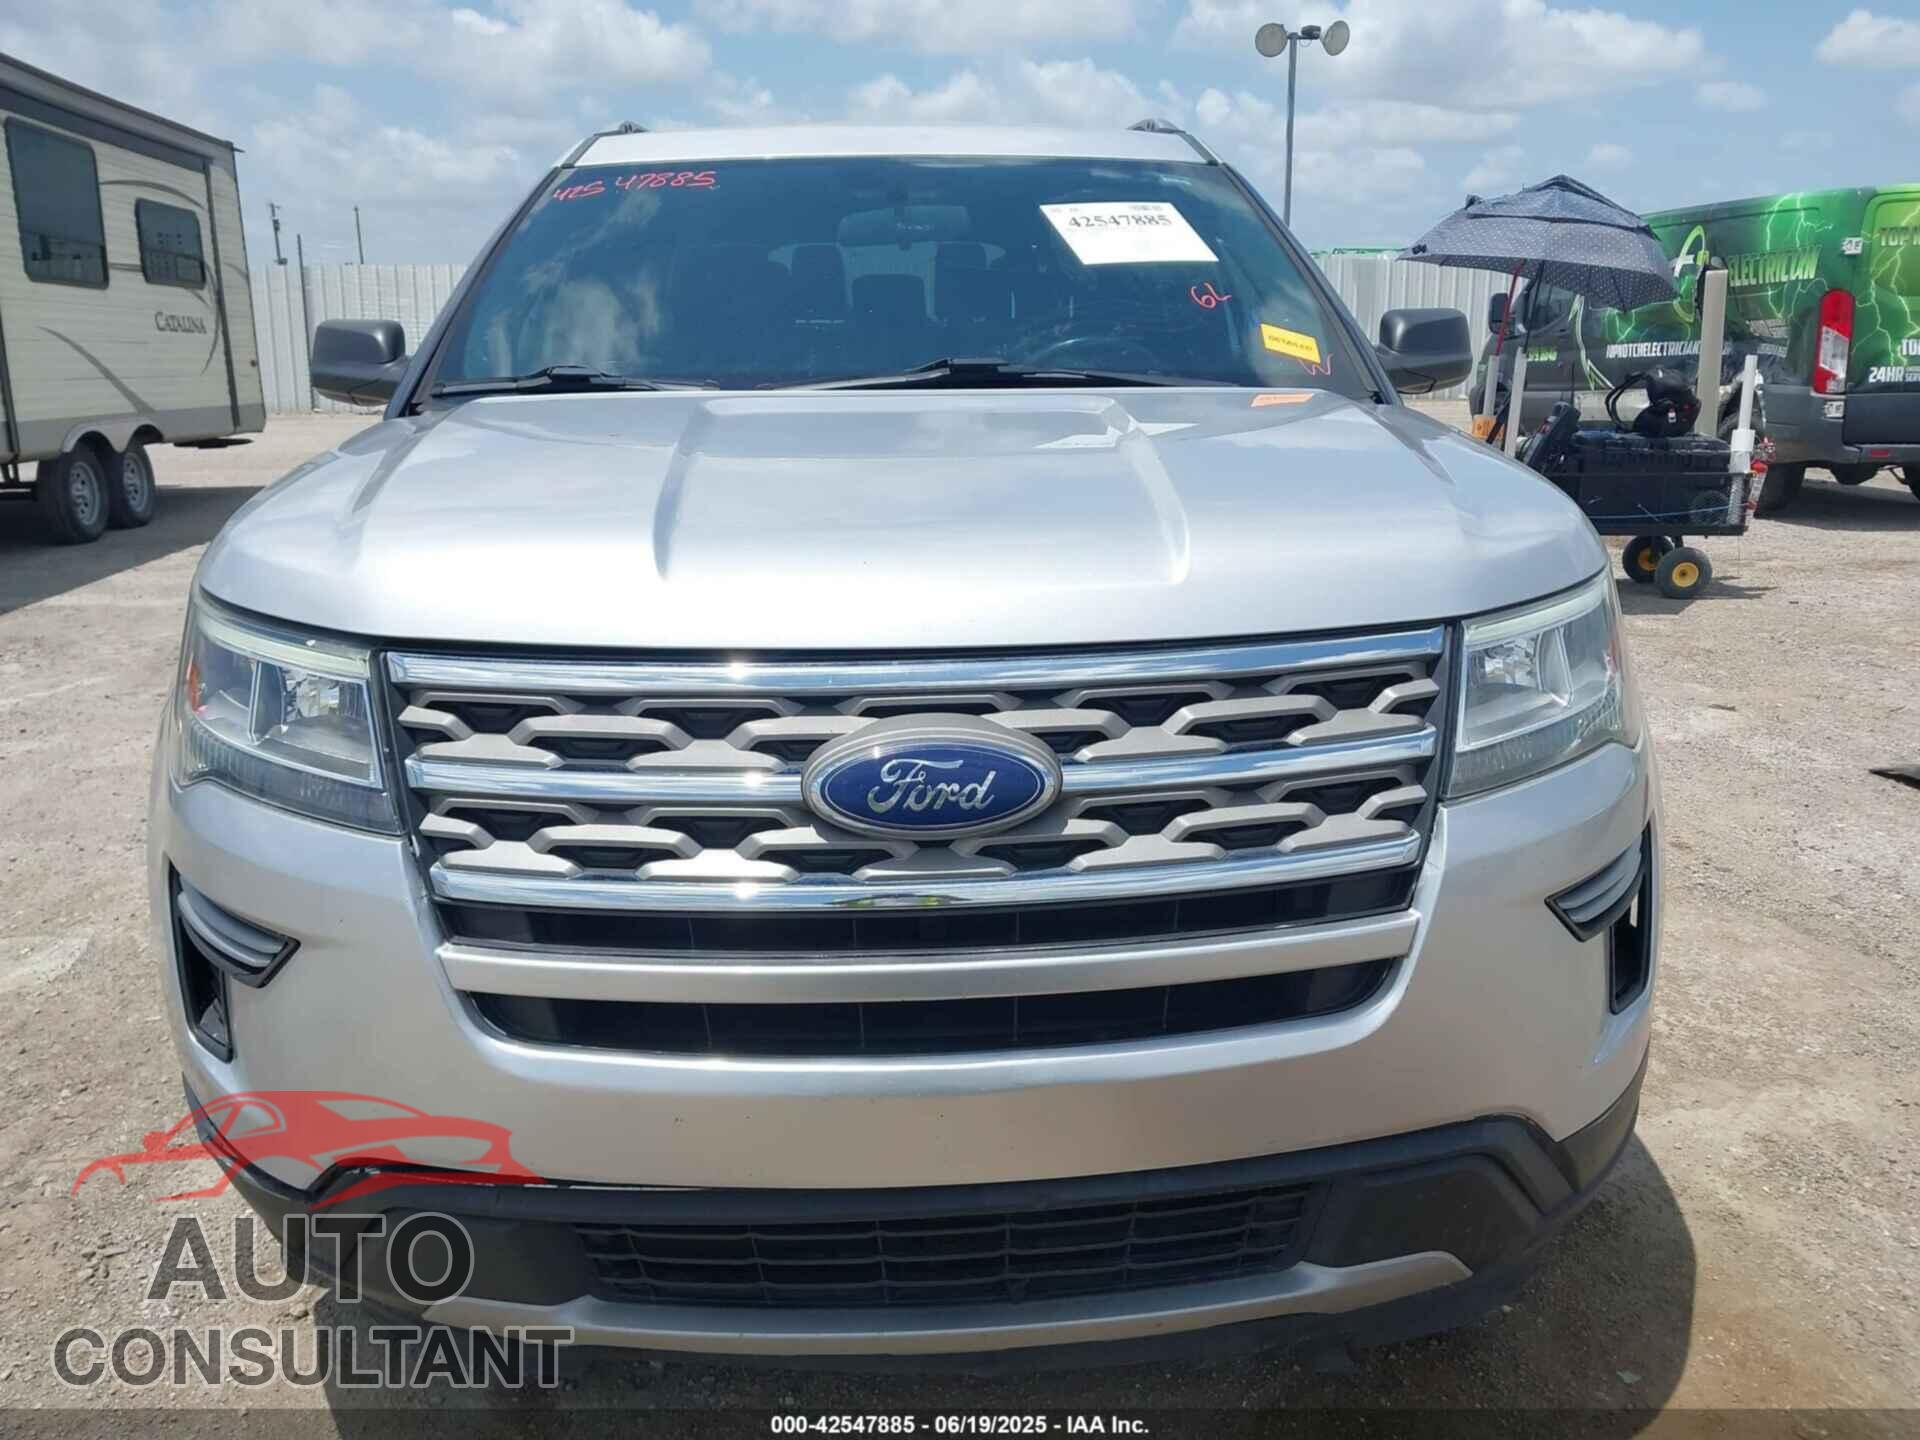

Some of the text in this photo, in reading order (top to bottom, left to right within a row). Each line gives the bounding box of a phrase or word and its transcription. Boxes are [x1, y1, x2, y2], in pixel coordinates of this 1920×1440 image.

[1069, 214, 1172, 228] 42547885
[1727, 246, 1819, 287] ELECTRICIAN
[1868, 366, 1905, 383] 24HR
[867, 758, 996, 814] Ford
